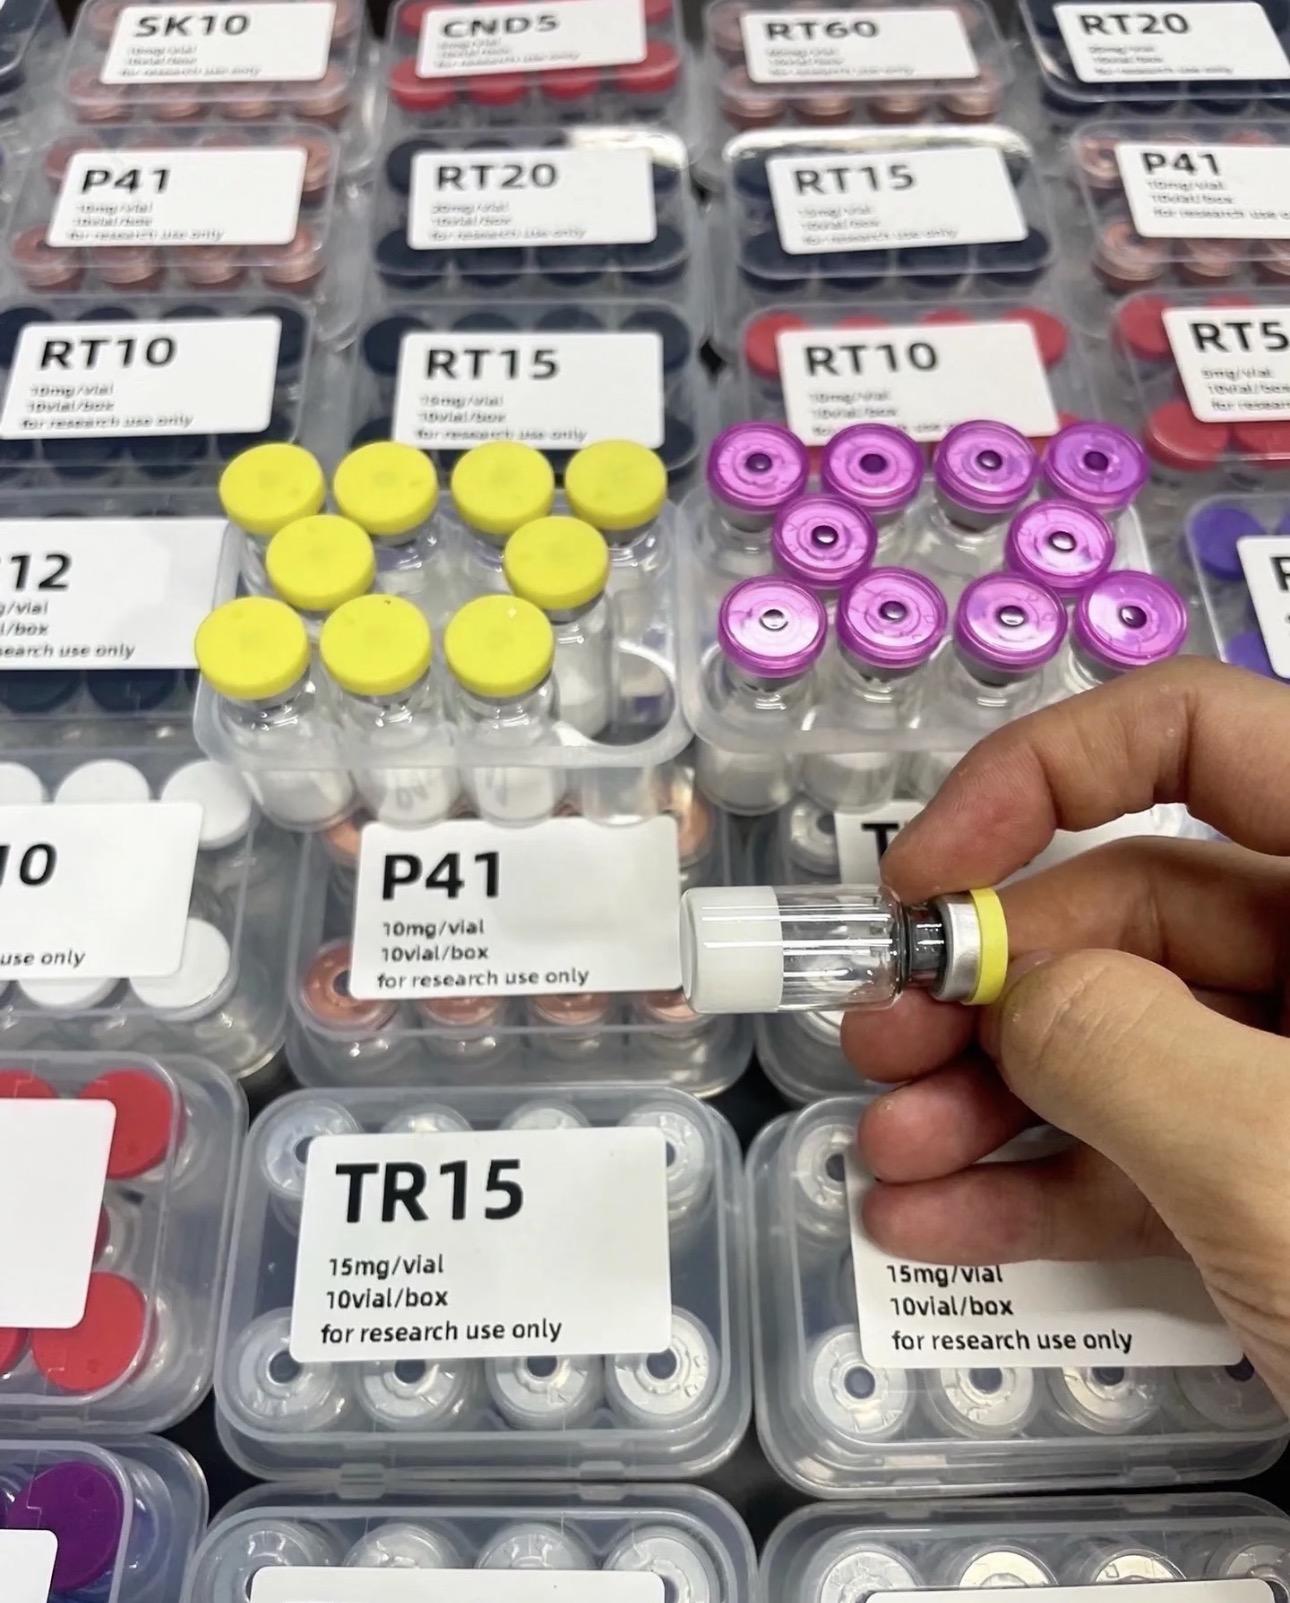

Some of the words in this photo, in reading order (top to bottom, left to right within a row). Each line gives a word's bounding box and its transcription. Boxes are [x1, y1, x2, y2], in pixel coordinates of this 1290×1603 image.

[134, 14, 249, 37] SK10
[442, 15, 559, 38] CND5
[766, 20, 878, 40] RT60
[1079, 13, 1189, 34] RT20
[437, 163, 557, 190] RT20
[1142, 153, 1220, 175] P41
[81, 168, 170, 193] P41
[796, 165, 914, 194] RT15
[1190, 322, 1289, 352] RT5
[40, 338, 175, 369] RT10
[426, 349, 559, 379] RT15
[806, 343, 937, 375] RT10
[0, 554, 71, 591] 12
[60, 646, 90, 657] use
[96, 643, 135, 660] only
[862, 823, 899, 862] T
[382, 851, 500, 900] P41
[383, 920, 484, 941] 10mg/vial
[41, 949, 85, 968] only
[382, 946, 488, 962] 10vial/box
[378, 974, 404, 990] for
[412, 970, 498, 988] research
[505, 973, 539, 986] use
[545, 967, 589, 987] only
[336, 1159, 524, 1223] TR15
[329, 1254, 444, 1279] 15mg/vial
[887, 1265, 1003, 1287] 15mg/vial
[327, 1289, 448, 1310] 10vial/box
[891, 1296, 1014, 1316] 10vial/box
[321, 1323, 354, 1344] for
[361, 1321, 458, 1342] research
[466, 1324, 505, 1340] use
[512, 1318, 562, 1343] only
[892, 1331, 924, 1350] for
[932, 1329, 1030, 1350] research
[1037, 1334, 1076, 1350] use
[1083, 1329, 1132, 1354] only
